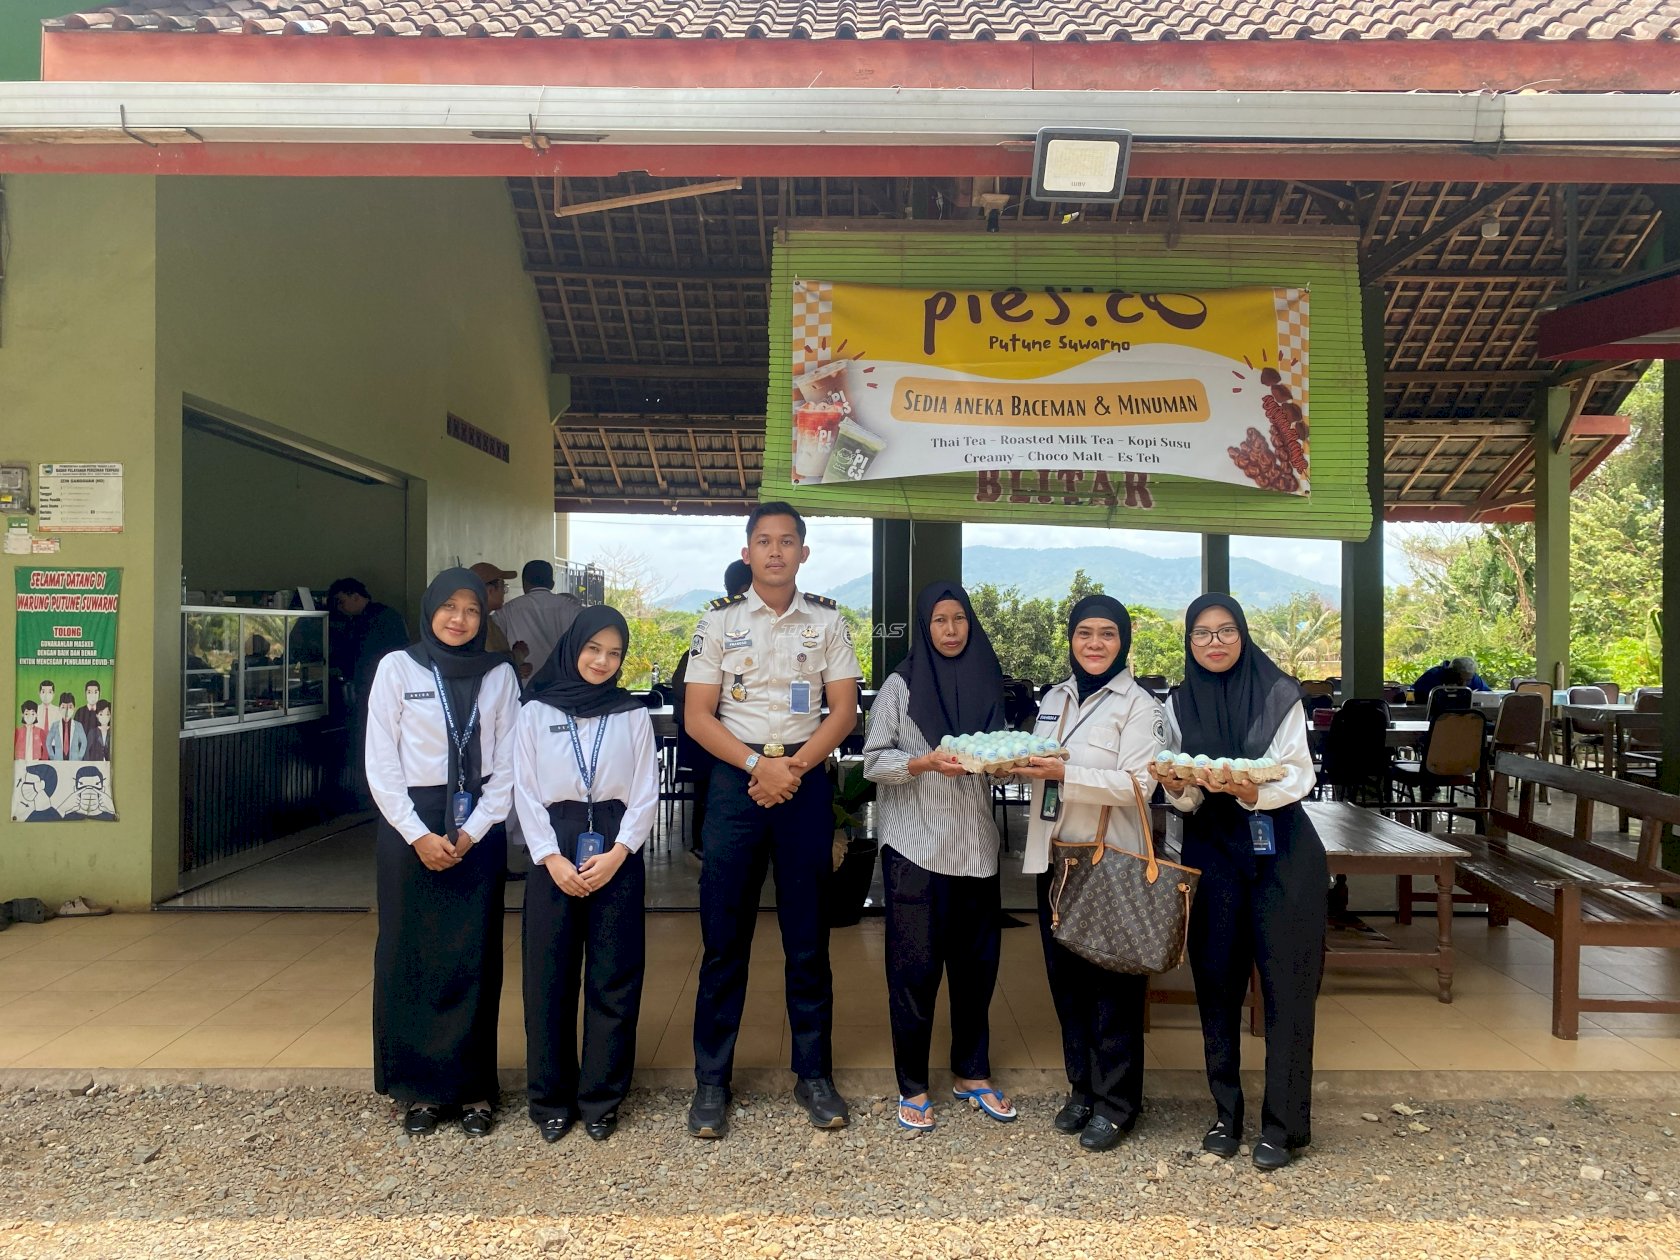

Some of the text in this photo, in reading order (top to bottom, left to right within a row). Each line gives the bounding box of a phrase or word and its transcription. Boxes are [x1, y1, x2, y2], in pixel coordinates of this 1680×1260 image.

[989, 333, 1130, 353] Putune Suwarno
[903, 389, 1198, 417] SEDIA ANEKA BACEMAN & MINUMAN
[930, 437, 960, 448] Thai
[963, 435, 986, 447] Tea
[1000, 434, 1054, 445] Roasted
[1058, 434, 1088, 445] Milk
[1091, 434, 1114, 445] Tea
[1128, 435, 1157, 449] Kopi
[1160, 437, 1191, 449] Susu
[964, 452, 1015, 464] Creamy
[1027, 450, 1069, 462] Choco
[1072, 451, 1105, 462] Malt
[1118, 452, 1133, 463] Es
[1136, 452, 1161, 464] Teh
[30, 571, 107, 589] SELAMAT DATANG DI
[16, 593, 50, 612] WARUNG
[51, 594, 82, 612] PUTUNE
[53, 626, 82, 638] TOLONG
